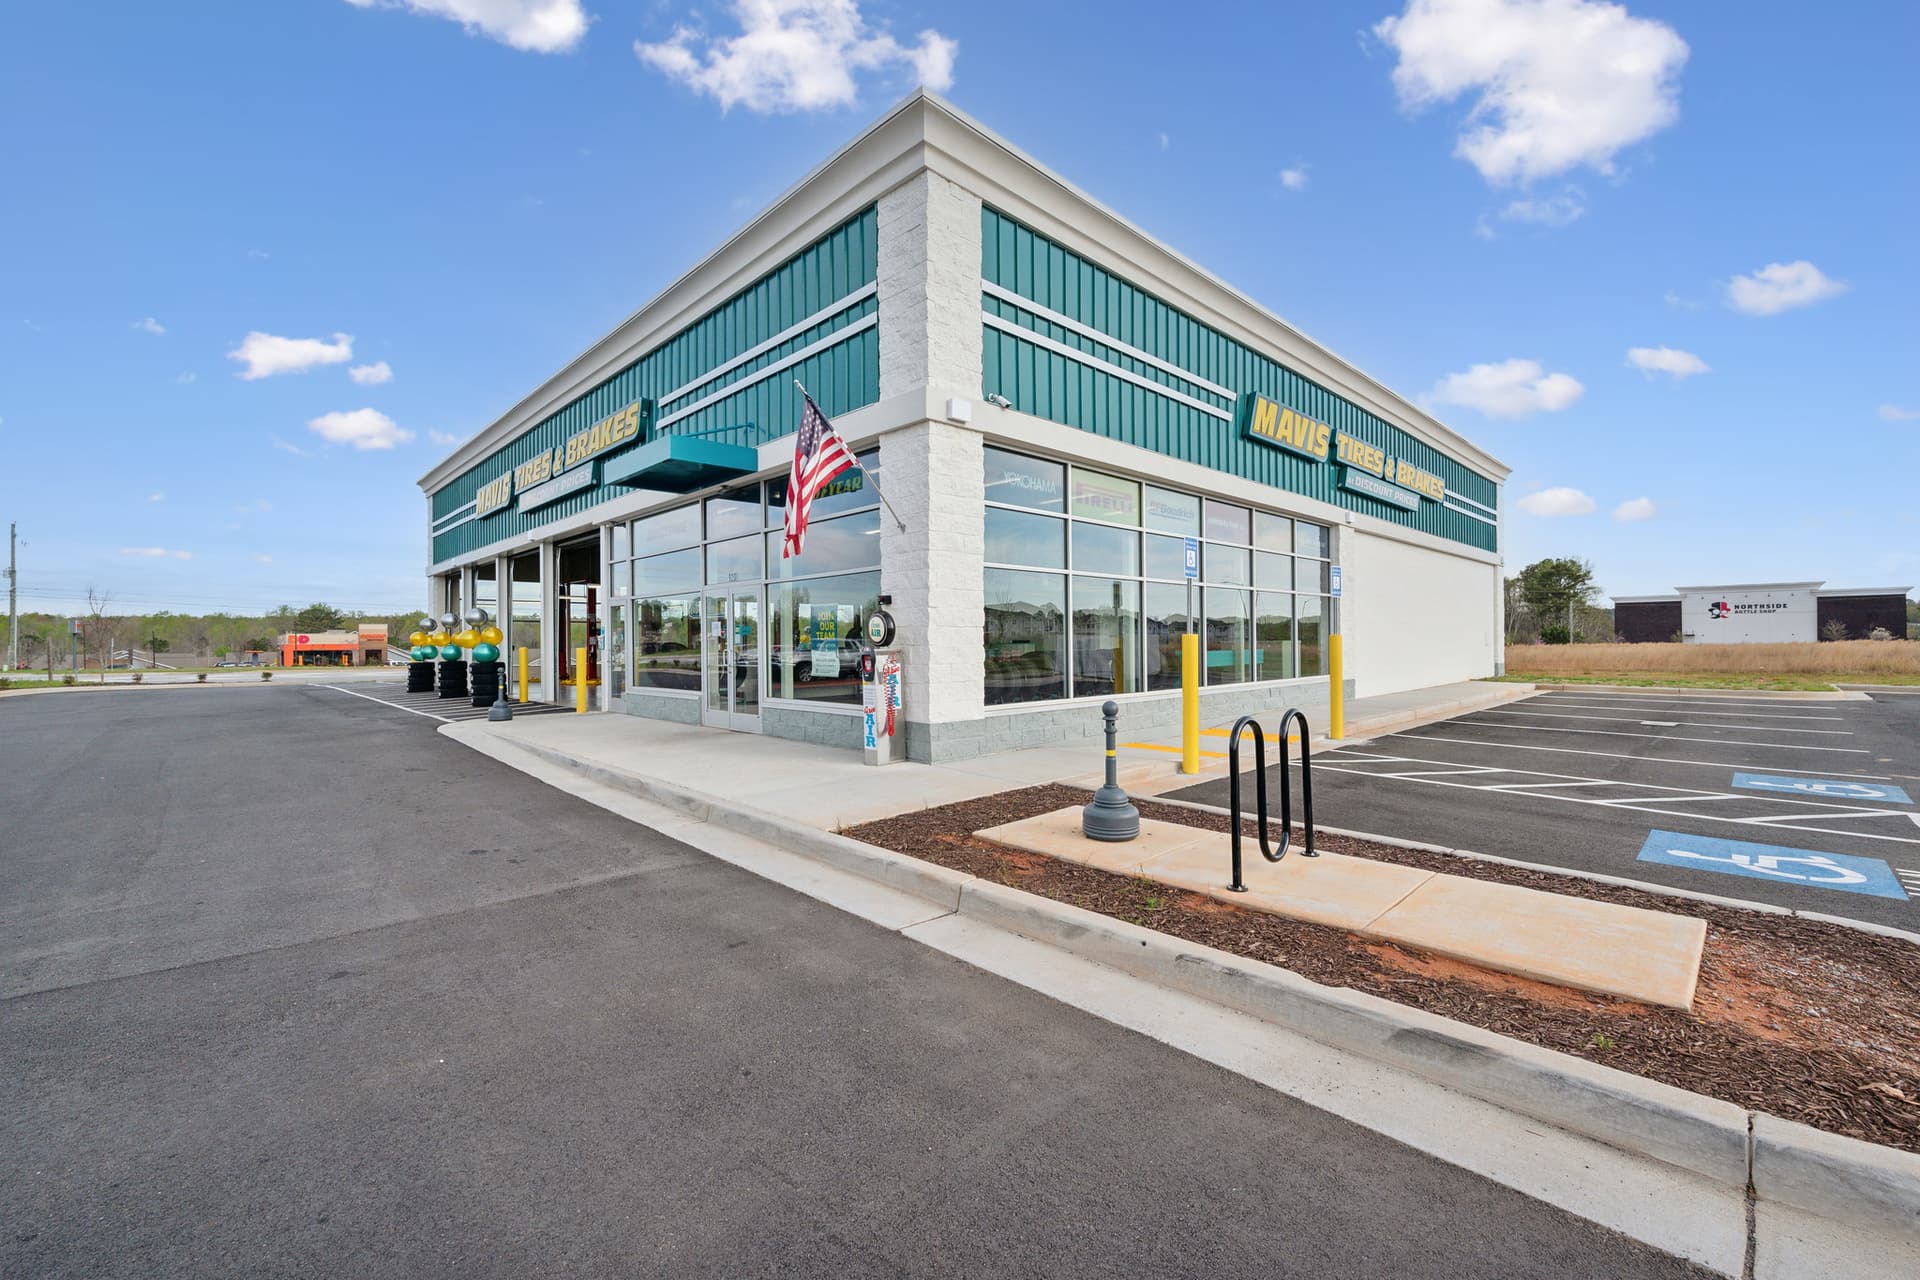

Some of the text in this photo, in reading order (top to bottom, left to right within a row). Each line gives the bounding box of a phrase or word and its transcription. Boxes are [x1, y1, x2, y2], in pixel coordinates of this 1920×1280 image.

[476, 402, 640, 515] MAVIS TIRES & BRAKES
[1253, 396, 1444, 501] MAVIS TIRES & BRAKES
[1003, 471, 1057, 495] YOKOHAMA
[1355, 476, 1393, 498] DISCOUNT
[1394, 490, 1418, 508] PRICES
[818, 611, 835, 621] JOIN
[820, 622, 835, 631] OUR
[815, 631, 835, 640] TEAM
[865, 714, 876, 747] AIR
